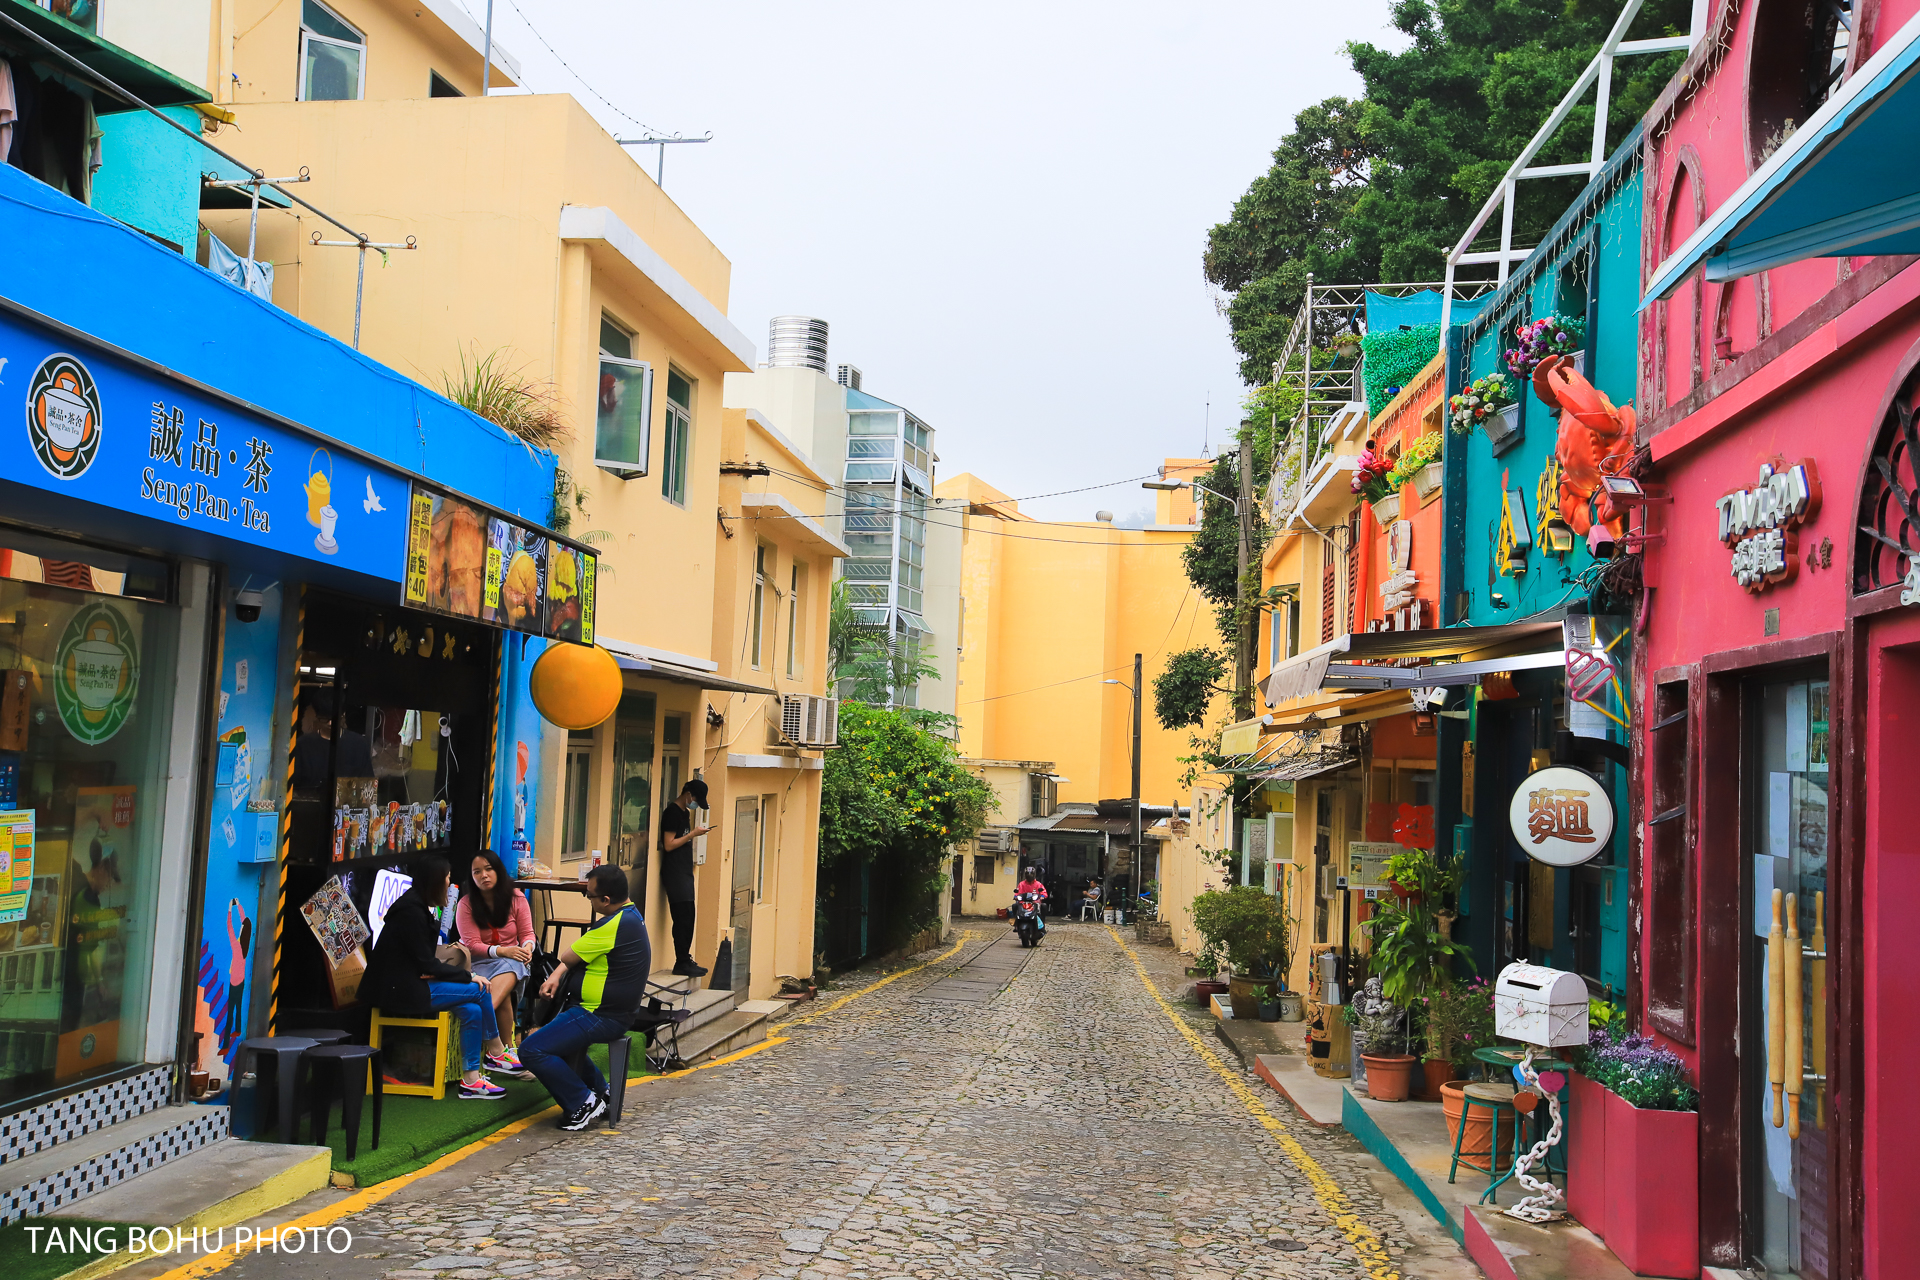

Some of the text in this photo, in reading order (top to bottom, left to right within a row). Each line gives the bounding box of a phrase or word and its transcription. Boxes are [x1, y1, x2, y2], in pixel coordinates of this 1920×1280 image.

[49, 420, 79, 436] Seng Pan Tea
[141, 467, 191, 520] Seng
[1715, 463, 1809, 541] TAVIRA
[408, 576, 426, 598] $40
[486, 590, 498, 605] $40
[80, 679, 114, 690] Seng Pan Tea
[1528, 788, 1597, 844] 麵
[1366, 889, 1375, 897] 拉
